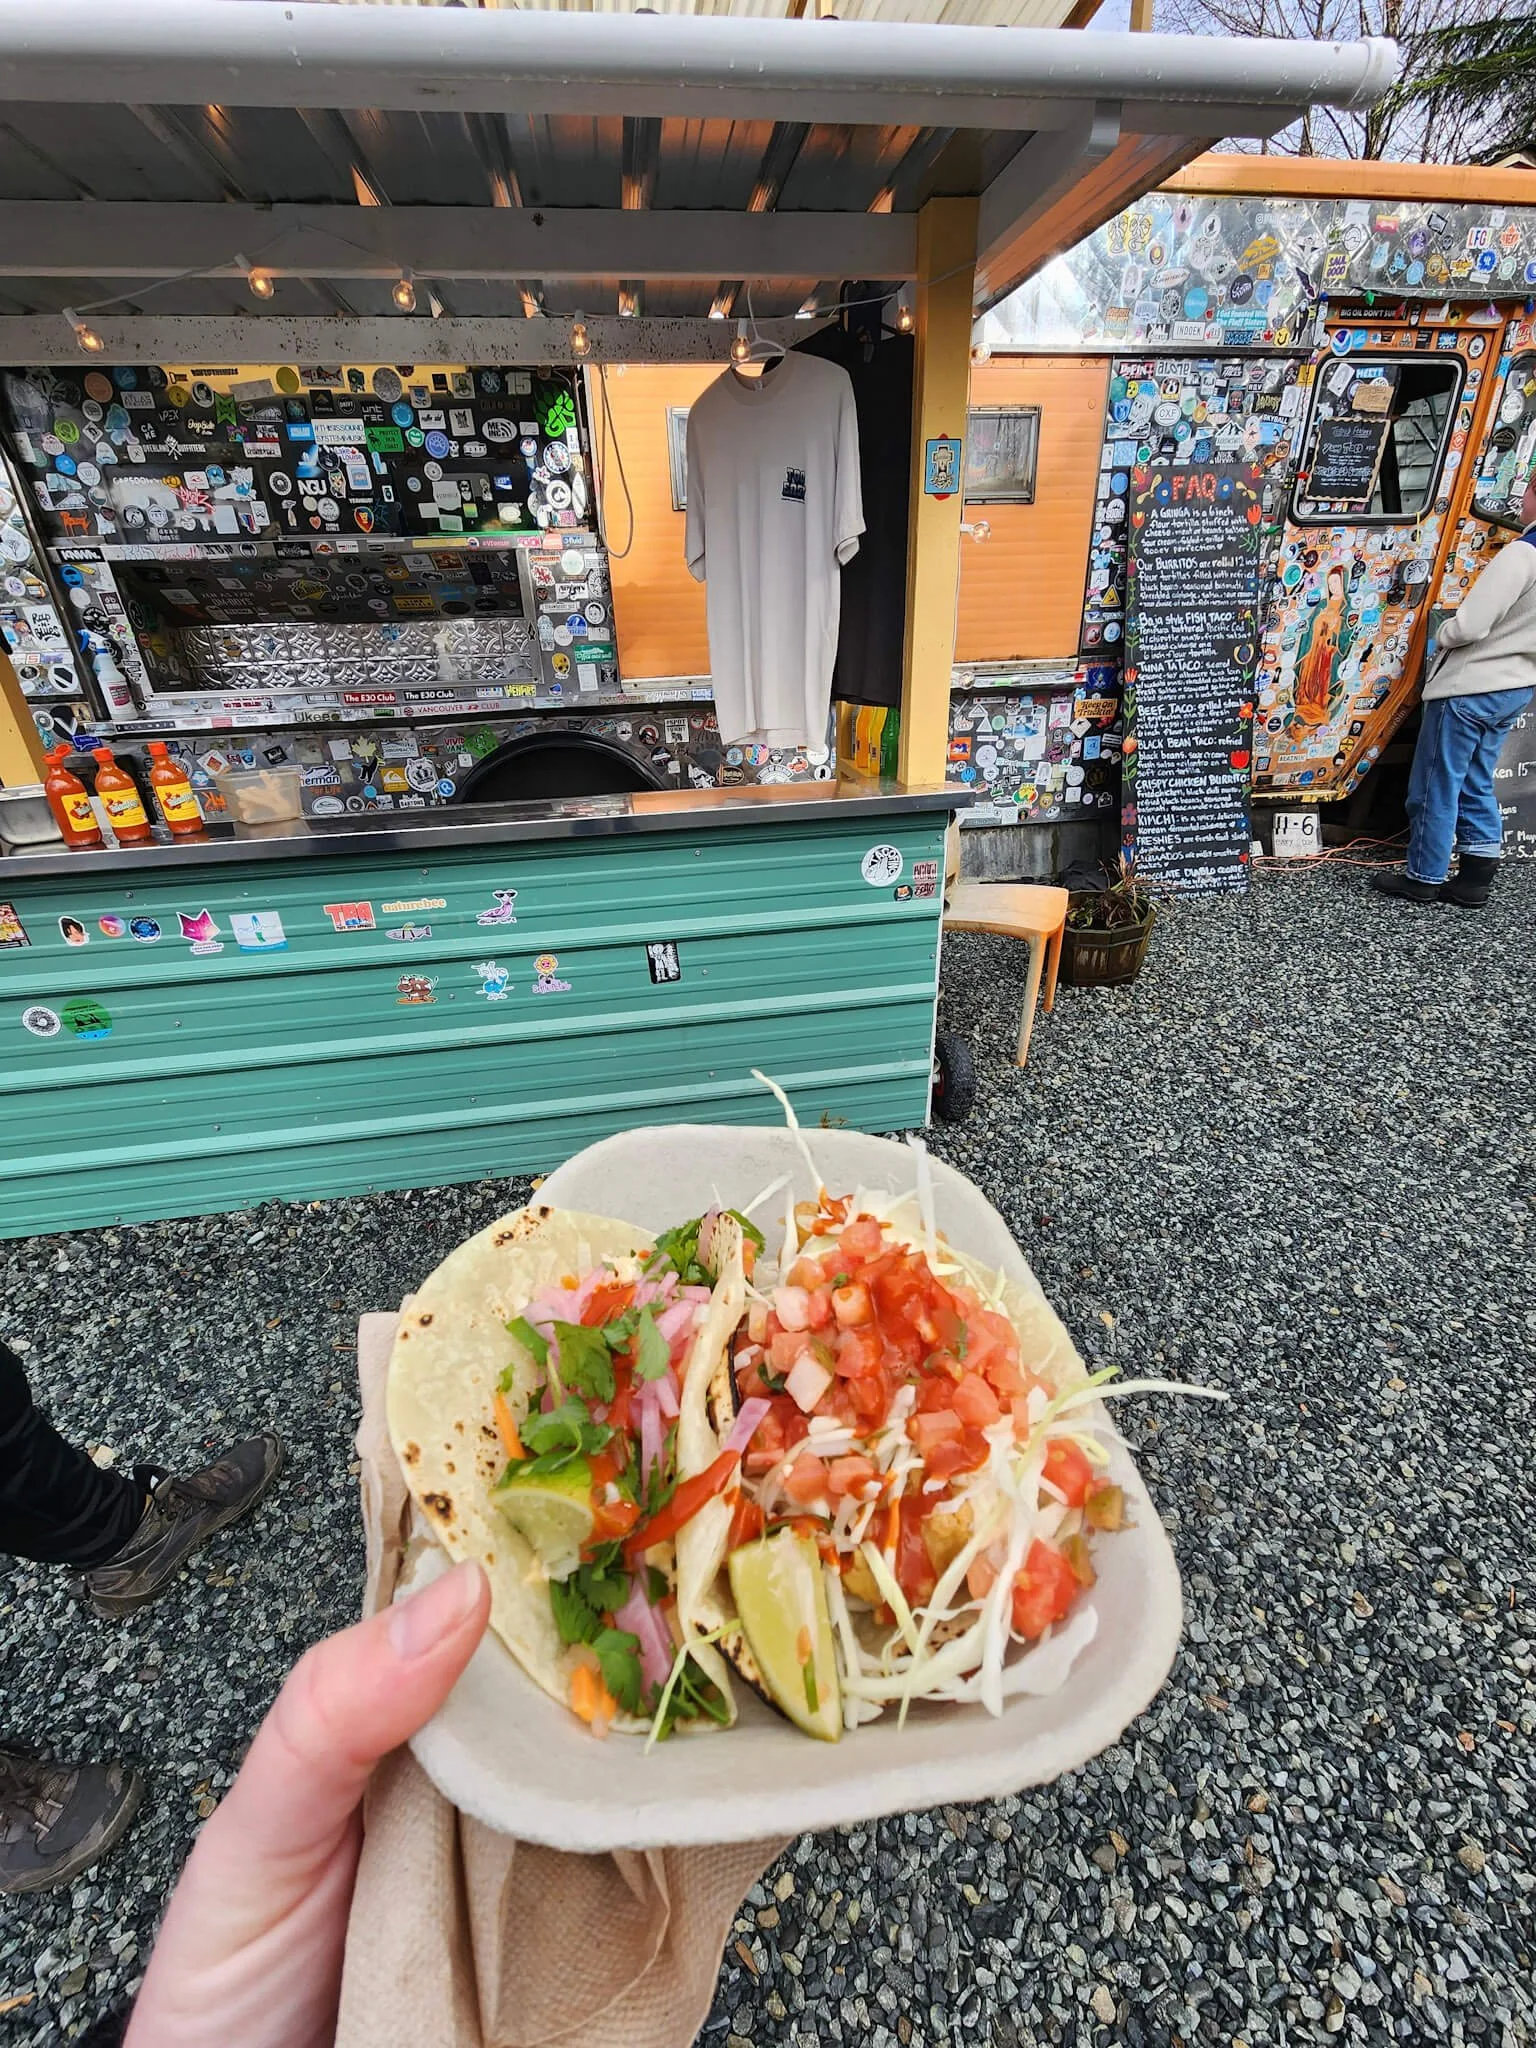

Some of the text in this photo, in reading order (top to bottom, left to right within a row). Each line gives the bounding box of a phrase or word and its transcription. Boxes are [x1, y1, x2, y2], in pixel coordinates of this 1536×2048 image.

[505, 371, 533, 396] 15
[1172, 474, 1216, 502] FAQ
[1151, 508, 1158, 519] A
[1160, 508, 1190, 518] GRINGA
[1193, 508, 1200, 516] is
[1150, 520, 1170, 529] flour
[1202, 517, 1229, 526] stuffed
[1231, 516, 1247, 525] with
[1136, 559, 1153, 571] Our
[1156, 557, 1198, 570] BURRITOS
[1138, 612, 1163, 627] Baja
[1185, 612, 1206, 623] FISH
[1208, 612, 1235, 622] TACO:
[1136, 661, 1164, 673] TUNA
[344, 692, 396, 703] The E30 Club
[405, 689, 455, 700] The E30 Club
[417, 702, 501, 714] VANCOUVER CLUB
[1101, 701, 1114, 709] On
[1137, 704, 1165, 716] BEEF
[1168, 703, 1196, 715] TACO:
[1137, 740, 1164, 750] BLACK
[1167, 738, 1191, 748] BEAN
[1138, 751, 1158, 761] black
[1135, 779, 1168, 790] CRISPY
[1168, 776, 1206, 787] CHICKEN
[1137, 834, 1182, 846] FRESHIES
[868, 847, 900, 878] TACOFINO
[1184, 867, 1215, 878] DIABLO
